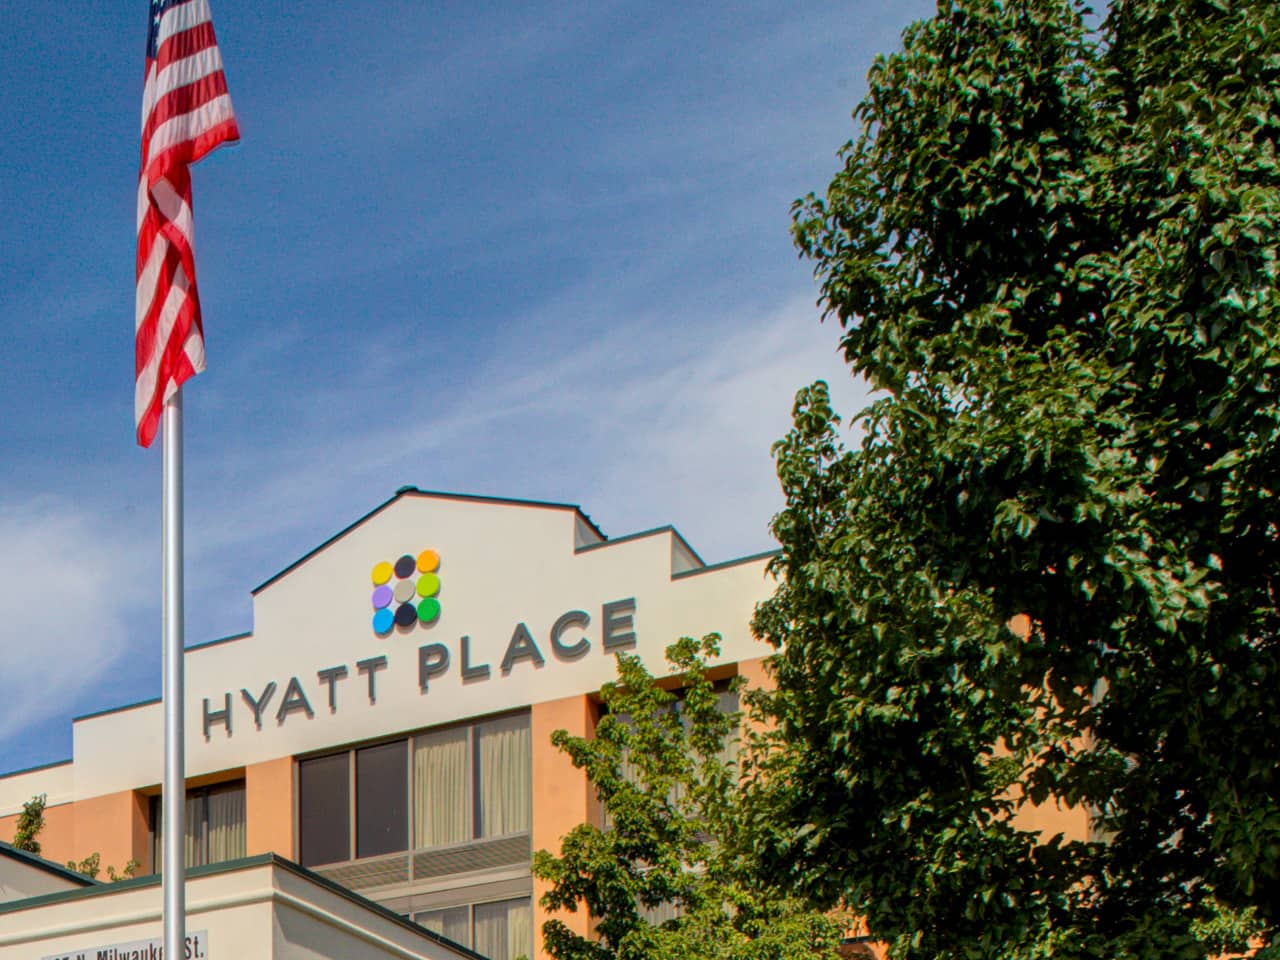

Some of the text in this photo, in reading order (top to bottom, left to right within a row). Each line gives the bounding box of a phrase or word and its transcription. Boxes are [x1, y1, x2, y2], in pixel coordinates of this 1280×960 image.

[202, 597, 637, 741] HYATT PLACE
[184, 936, 204, 960] St.
